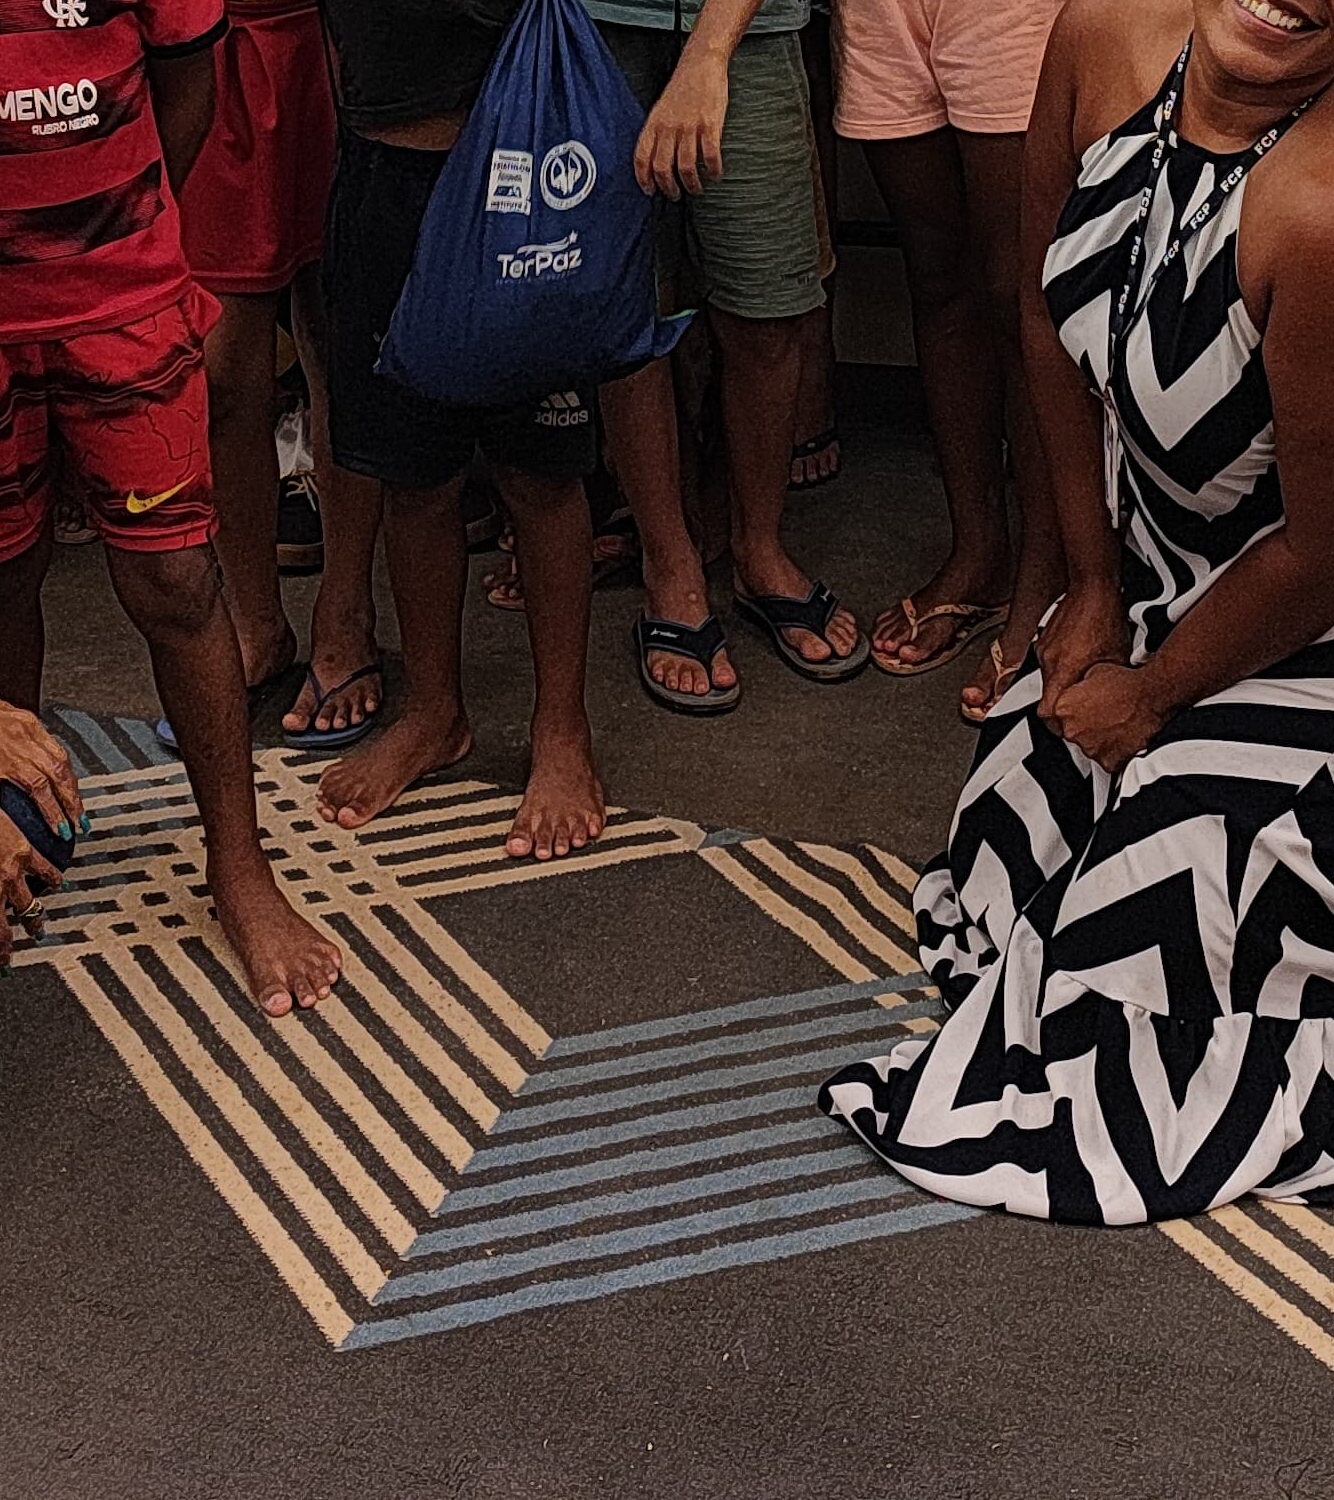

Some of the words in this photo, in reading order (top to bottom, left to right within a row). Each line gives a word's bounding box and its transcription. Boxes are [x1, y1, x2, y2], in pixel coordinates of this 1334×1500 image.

[32, 120, 67, 136] RUBRO
[68, 112, 100, 132] NEGRO
[497, 248, 582, 278] TerPaz
